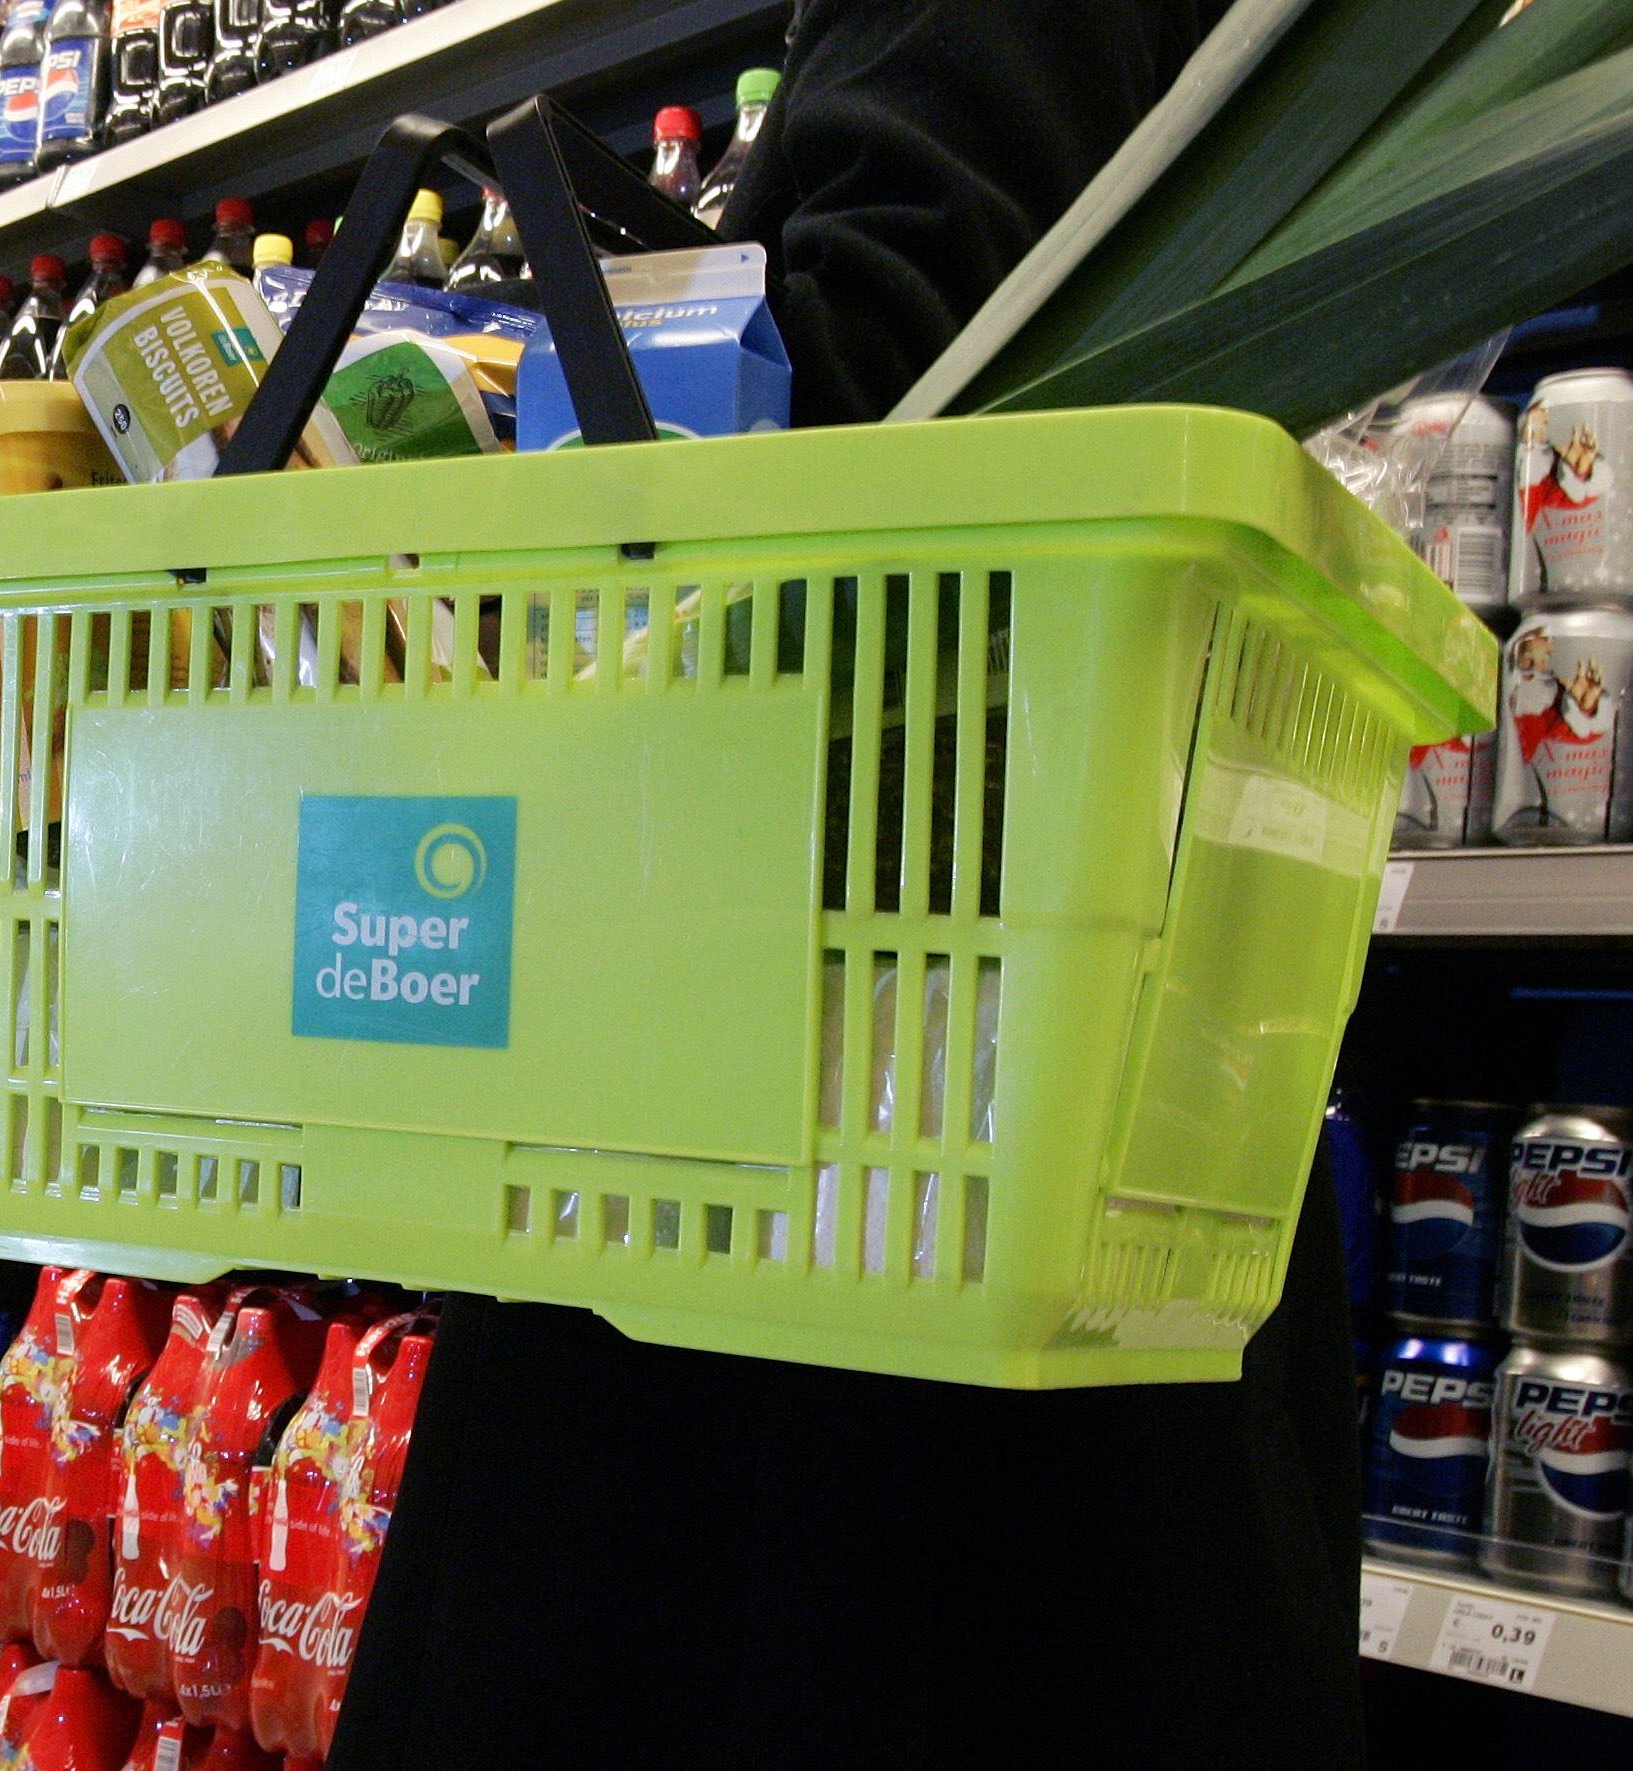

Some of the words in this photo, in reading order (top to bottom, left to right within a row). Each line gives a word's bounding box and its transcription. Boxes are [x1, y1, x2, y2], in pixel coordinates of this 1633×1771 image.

[617, 305, 718, 321] lcium
[133, 325, 201, 428] BISCUITS
[159, 305, 234, 417] VOLKOREN
[332, 902, 469, 956] Super
[315, 952, 480, 1006] deBoer
[1515, 1410, 1596, 1456] light
[1490, 1623, 1537, 1646] 0,39
